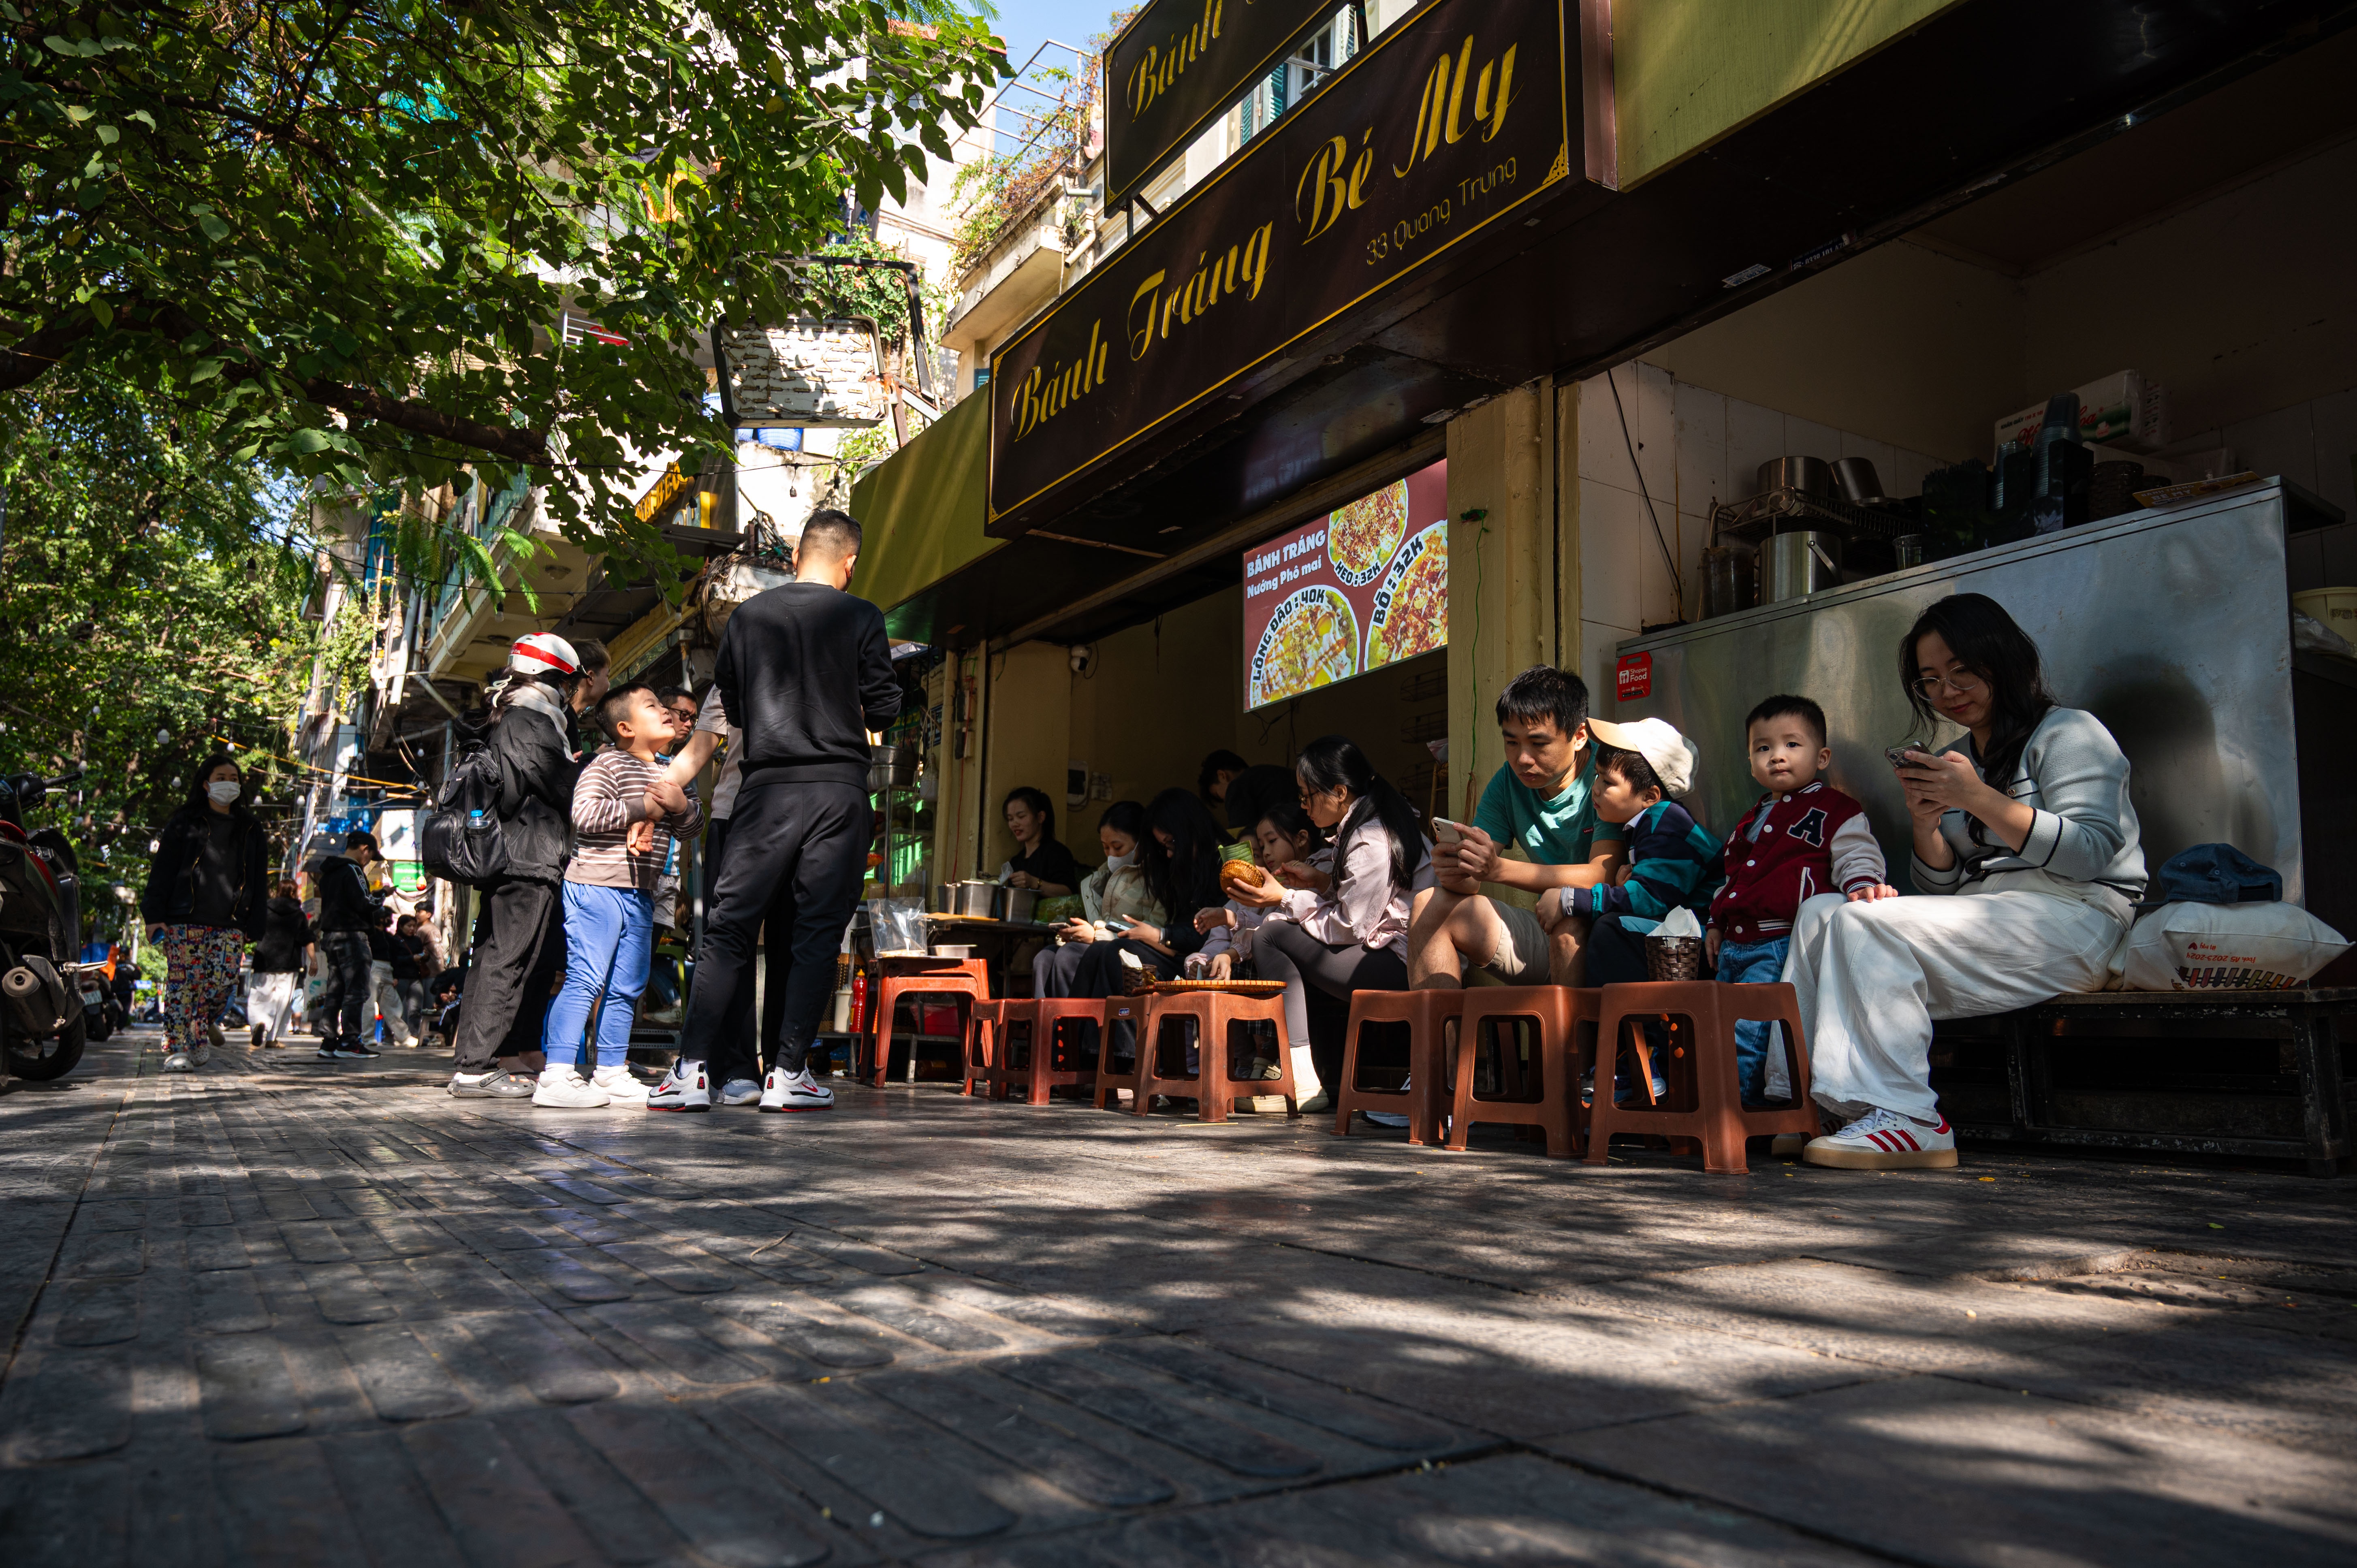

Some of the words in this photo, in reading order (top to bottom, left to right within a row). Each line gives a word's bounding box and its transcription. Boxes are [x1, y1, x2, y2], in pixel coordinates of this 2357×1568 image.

[1366, 232, 1388, 265] 33
[1394, 198, 1450, 251] Quang
[1457, 157, 1516, 222] Trung
[1012, 318, 1107, 443] Bánh
[1128, 220, 1275, 361] Tráng
[1296, 126, 1377, 245] Bé
[1393, 34, 1525, 179] My
[1247, 549, 1280, 578] BÁNH
[1283, 529, 1326, 562] TRÁNG
[1335, 561, 1353, 584] HEO
[1361, 561, 1381, 584] 32K
[1393, 535, 1423, 579] 32K
[1247, 577, 1278, 599] Nướng
[1280, 565, 1299, 585] Phô
[1301, 555, 1322, 576] mai
[1301, 589, 1325, 604] 40K
[1630, 672, 1647, 682] Food
[1787, 806, 1828, 848] A
[2186, 952, 2229, 962] 2023-2024
[1905, 1128, 1916, 1139] SAMBA
